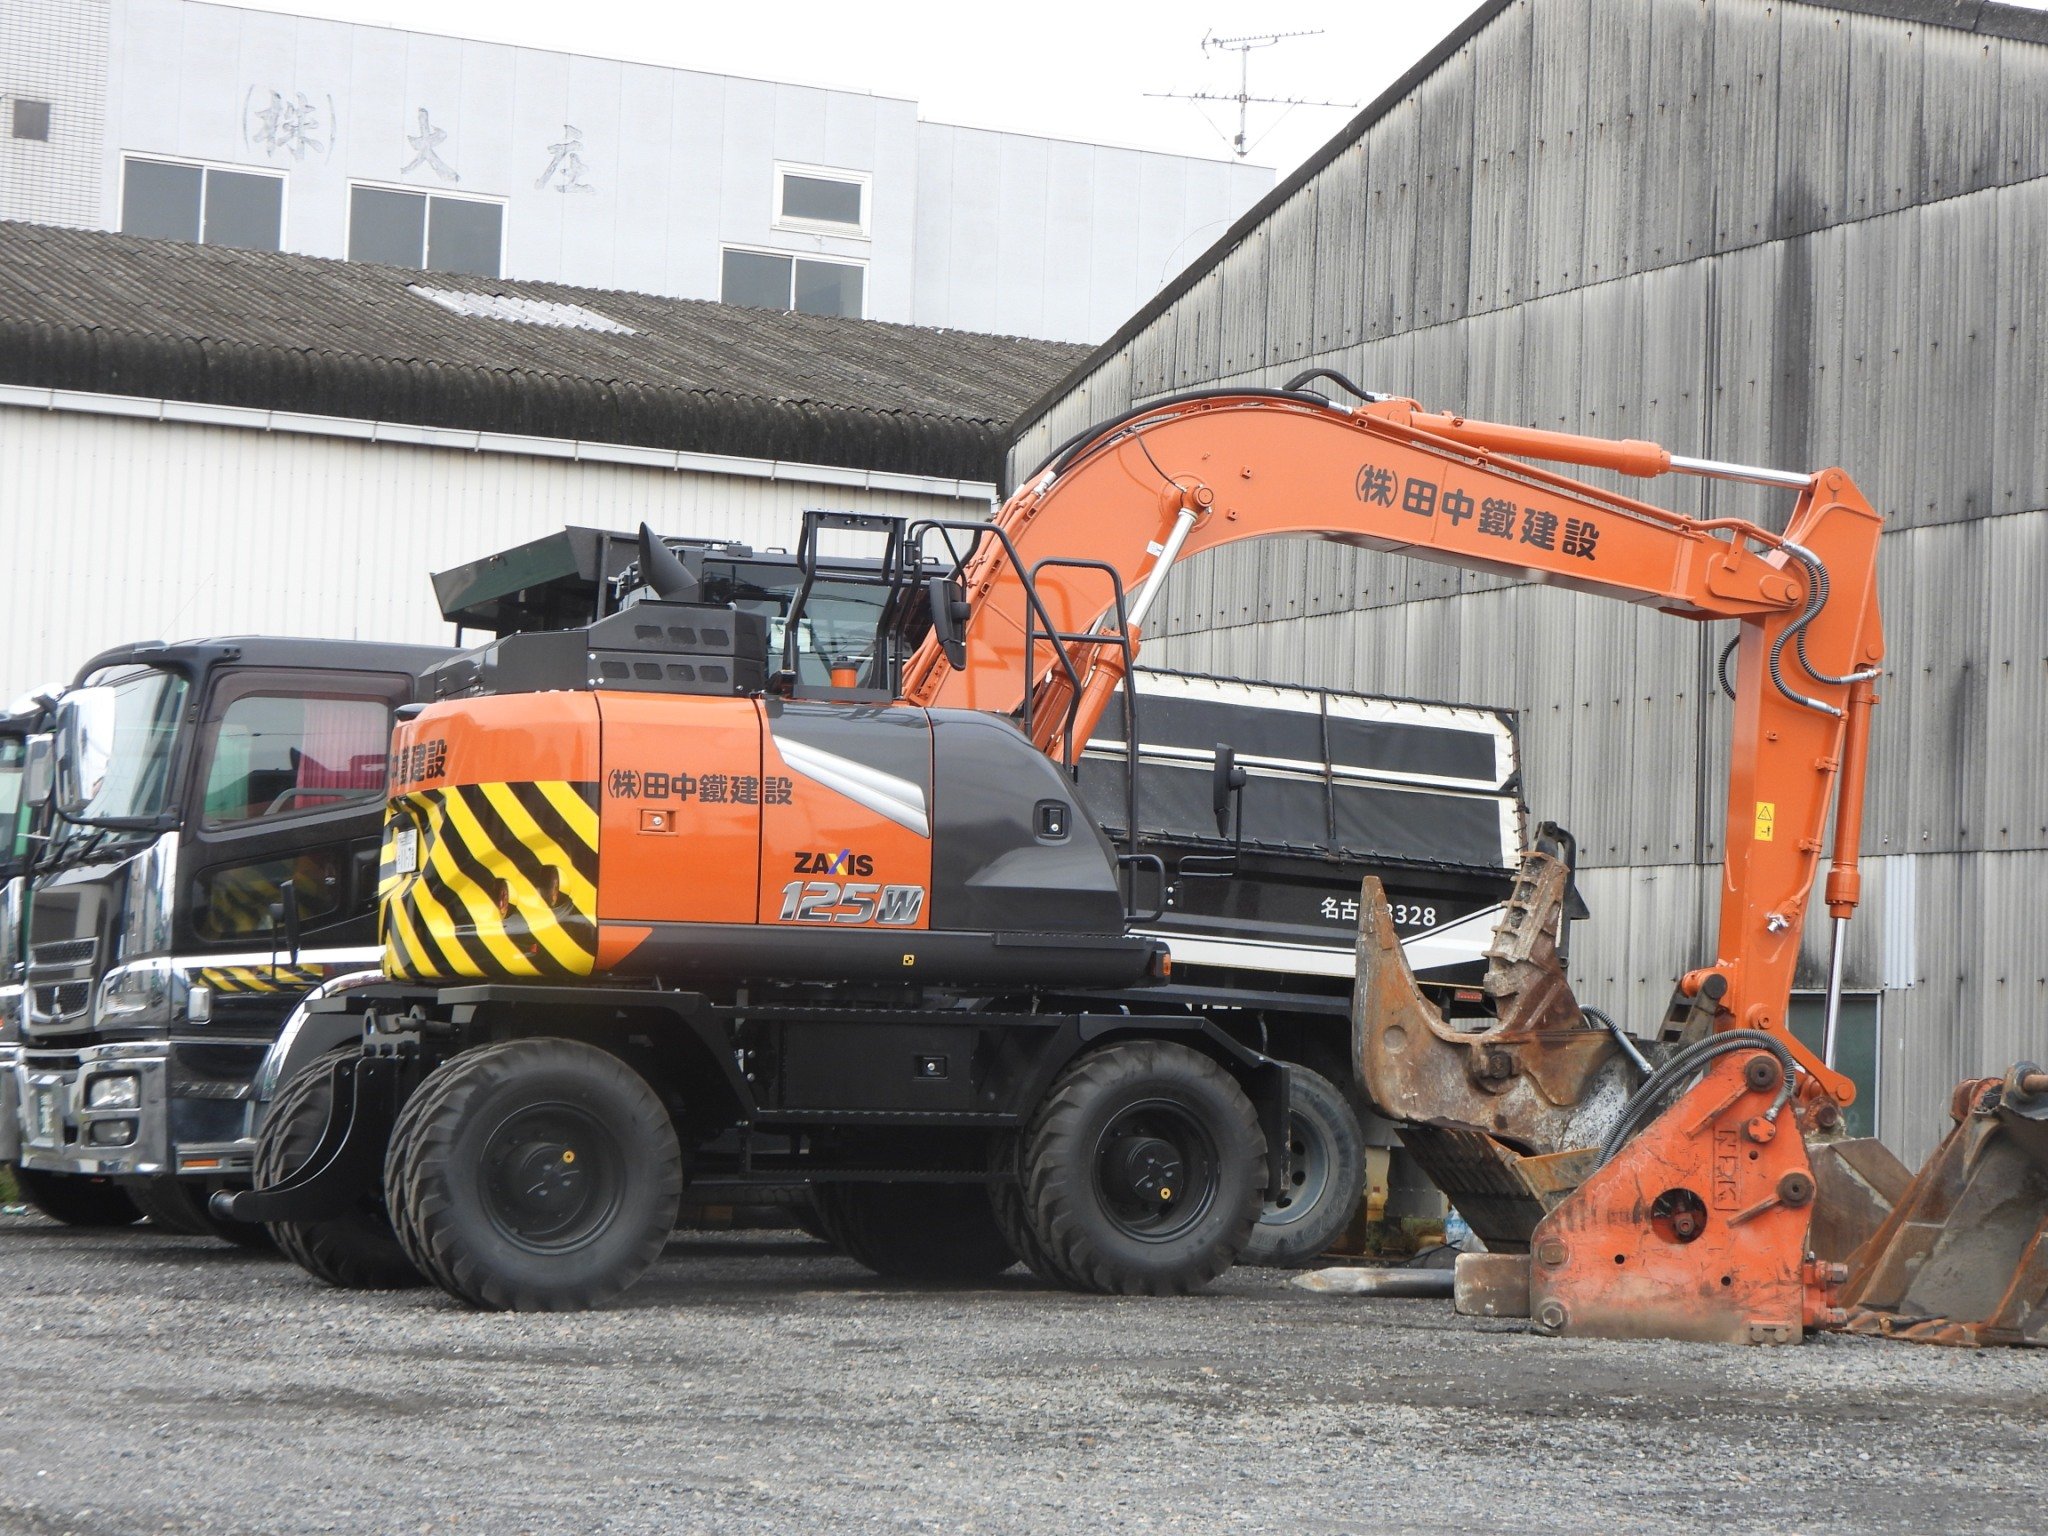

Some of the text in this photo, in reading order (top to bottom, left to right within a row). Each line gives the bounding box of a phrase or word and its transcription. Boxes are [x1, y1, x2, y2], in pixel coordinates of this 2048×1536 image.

[1356, 463, 1600, 561] (株)田中鐵建設
[607, 769, 793, 805] (株)田中鐵建設
[794, 849, 874, 877] ZAXIS
[779, 880, 926, 925] 125W
